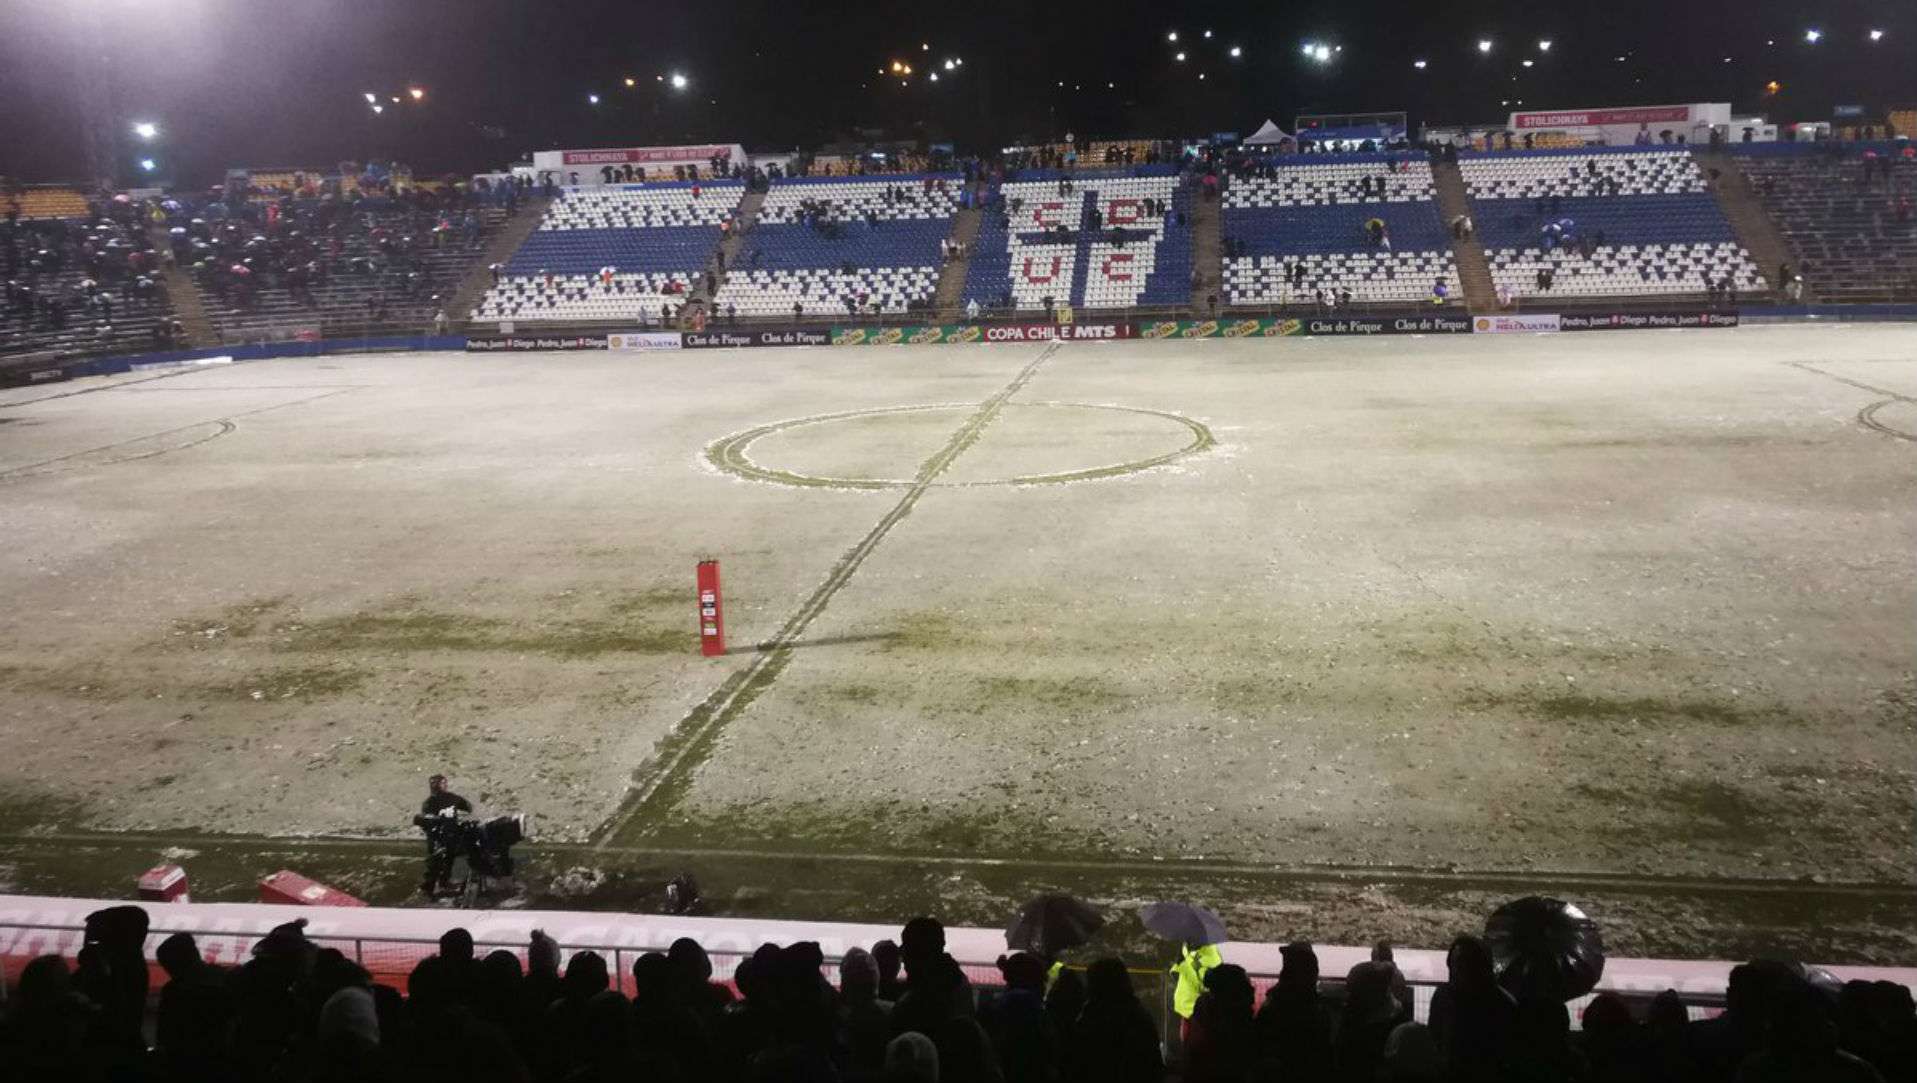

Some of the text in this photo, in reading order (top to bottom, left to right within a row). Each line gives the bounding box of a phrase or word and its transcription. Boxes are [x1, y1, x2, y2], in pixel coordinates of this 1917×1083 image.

[1022, 256, 1061, 284] U
[1310, 320, 1382, 334] Clos de Pirque
[1394, 318, 1468, 332] Clos de Pirque
[987, 327, 1025, 340] COPA
[1027, 326, 1071, 340] CHILE
[1074, 325, 1116, 338] MTS
